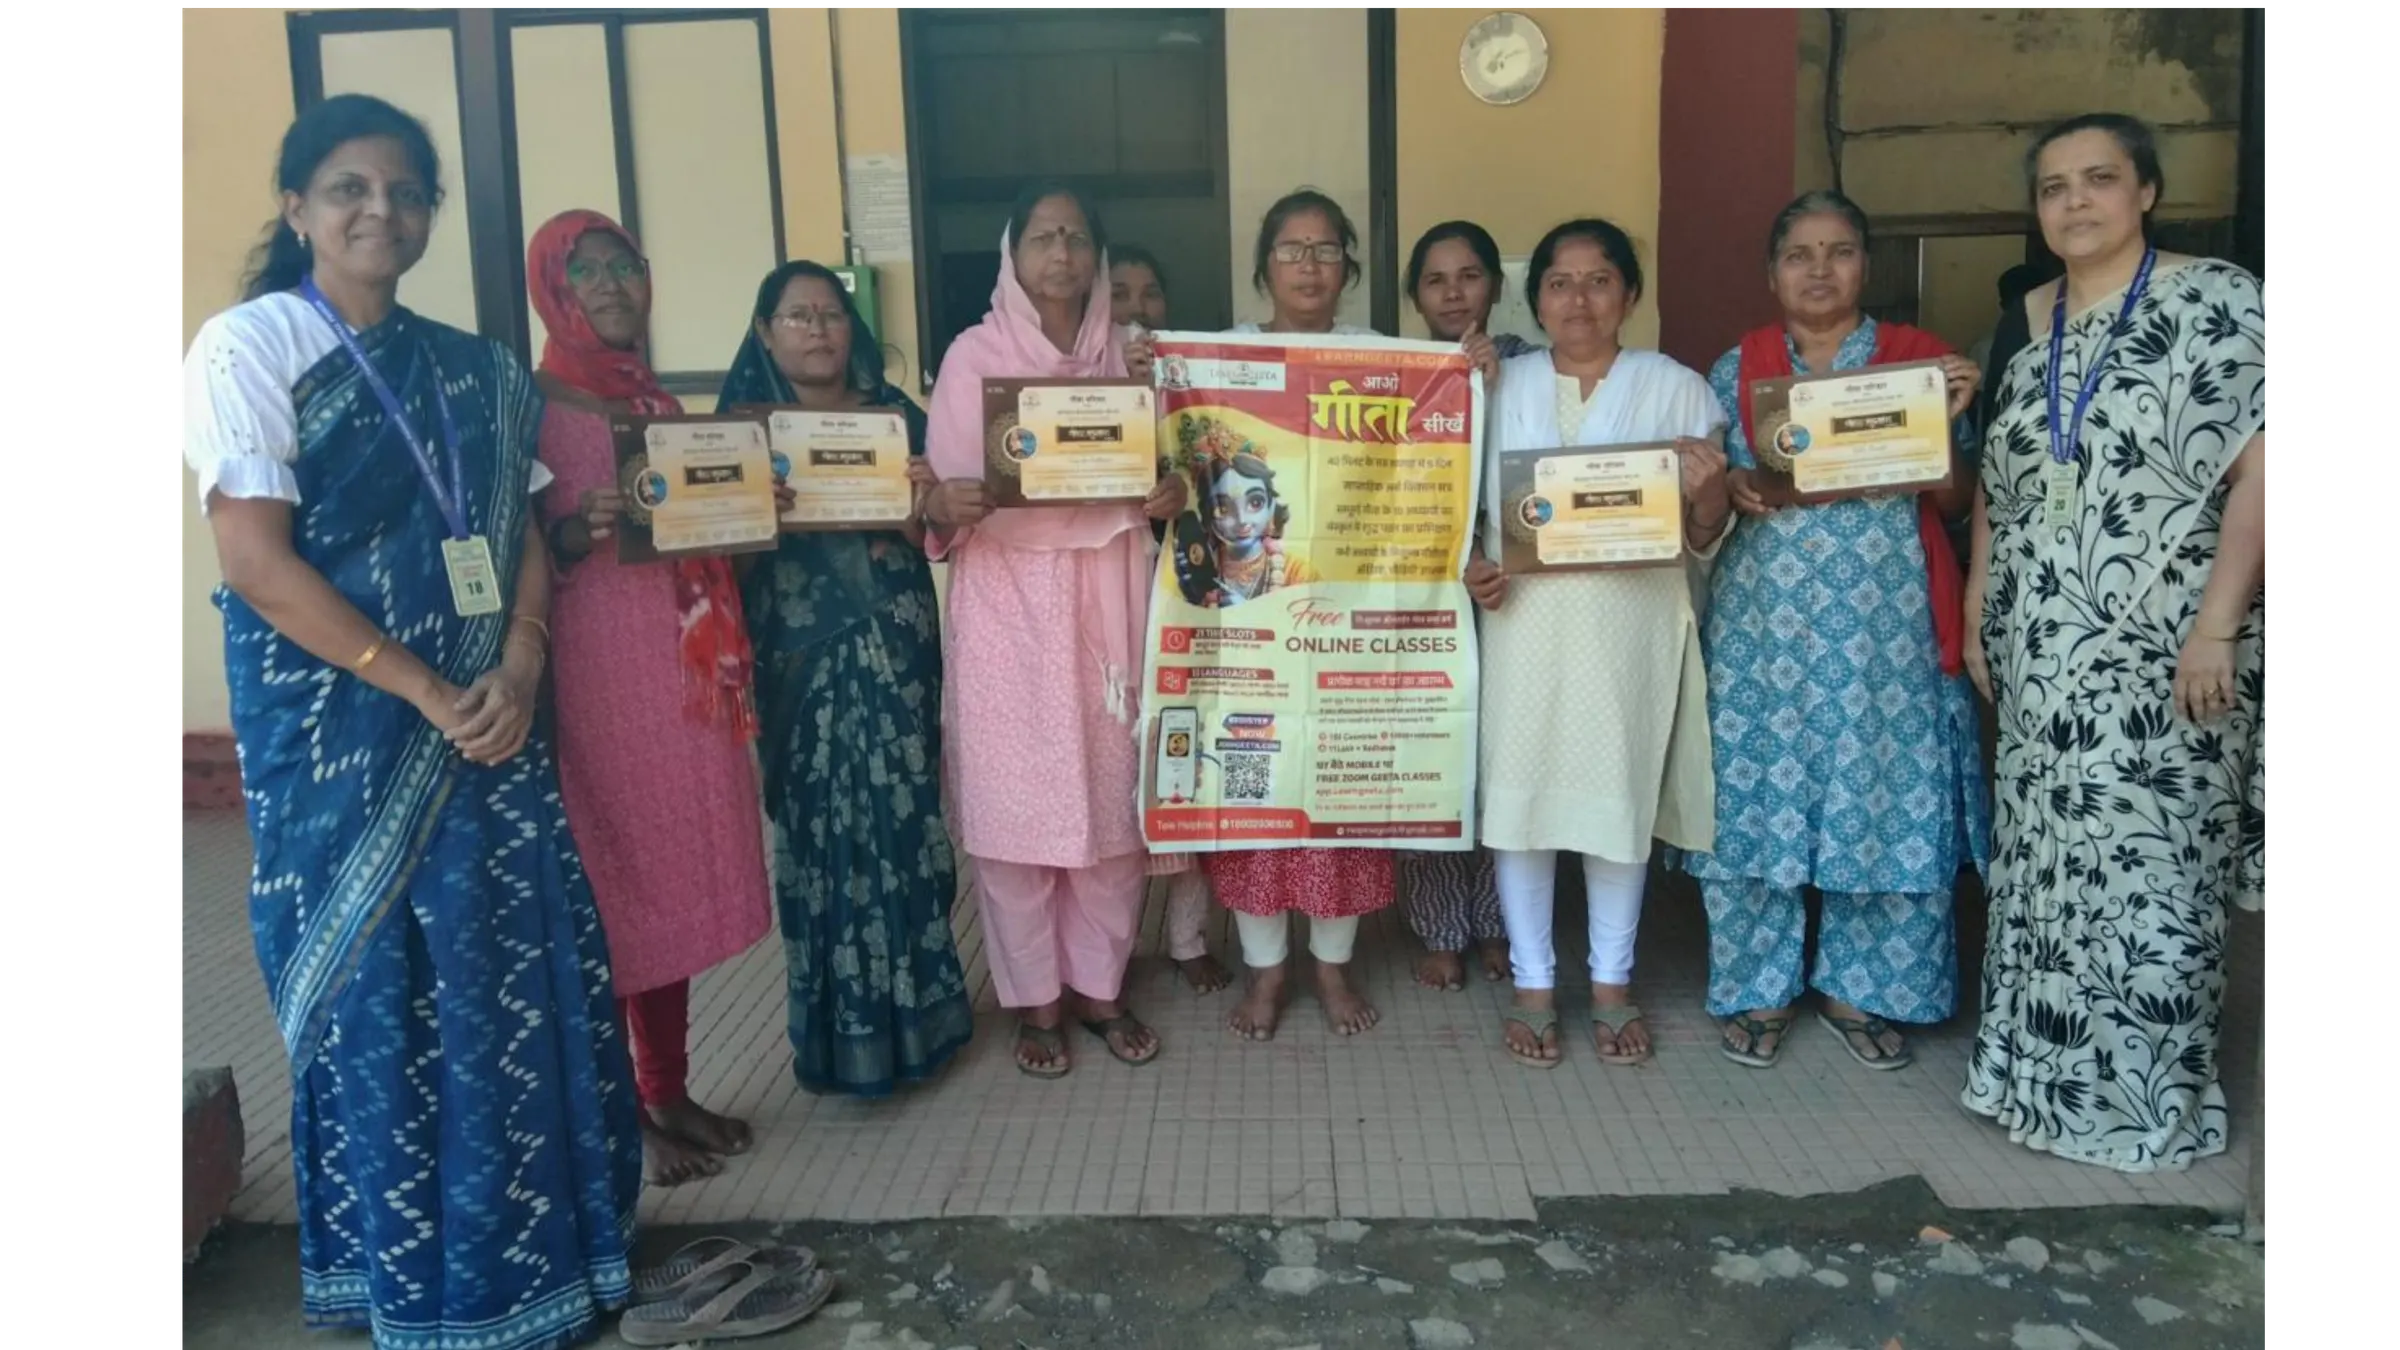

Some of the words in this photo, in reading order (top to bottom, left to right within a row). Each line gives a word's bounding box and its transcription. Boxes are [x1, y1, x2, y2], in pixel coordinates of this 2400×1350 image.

[1314, 352, 1450, 367] LEARNGEETA.COM
[1362, 372, 1400, 391] आओ
[1305, 379, 1417, 444] गीता
[1421, 412, 1465, 433] सीखें
[1286, 597, 1345, 631] Free
[1225, 629, 1257, 639] SLOTS
[1285, 636, 1365, 653] ONLINE
[1369, 636, 1457, 653] CLASSES
[1201, 668, 1258, 678] LANGUAGES
[1315, 773, 1340, 783] FREE
[1341, 773, 1369, 782] ZOOM
[1370, 772, 1401, 782] GEETA
[1401, 772, 1442, 782] CLASSES
